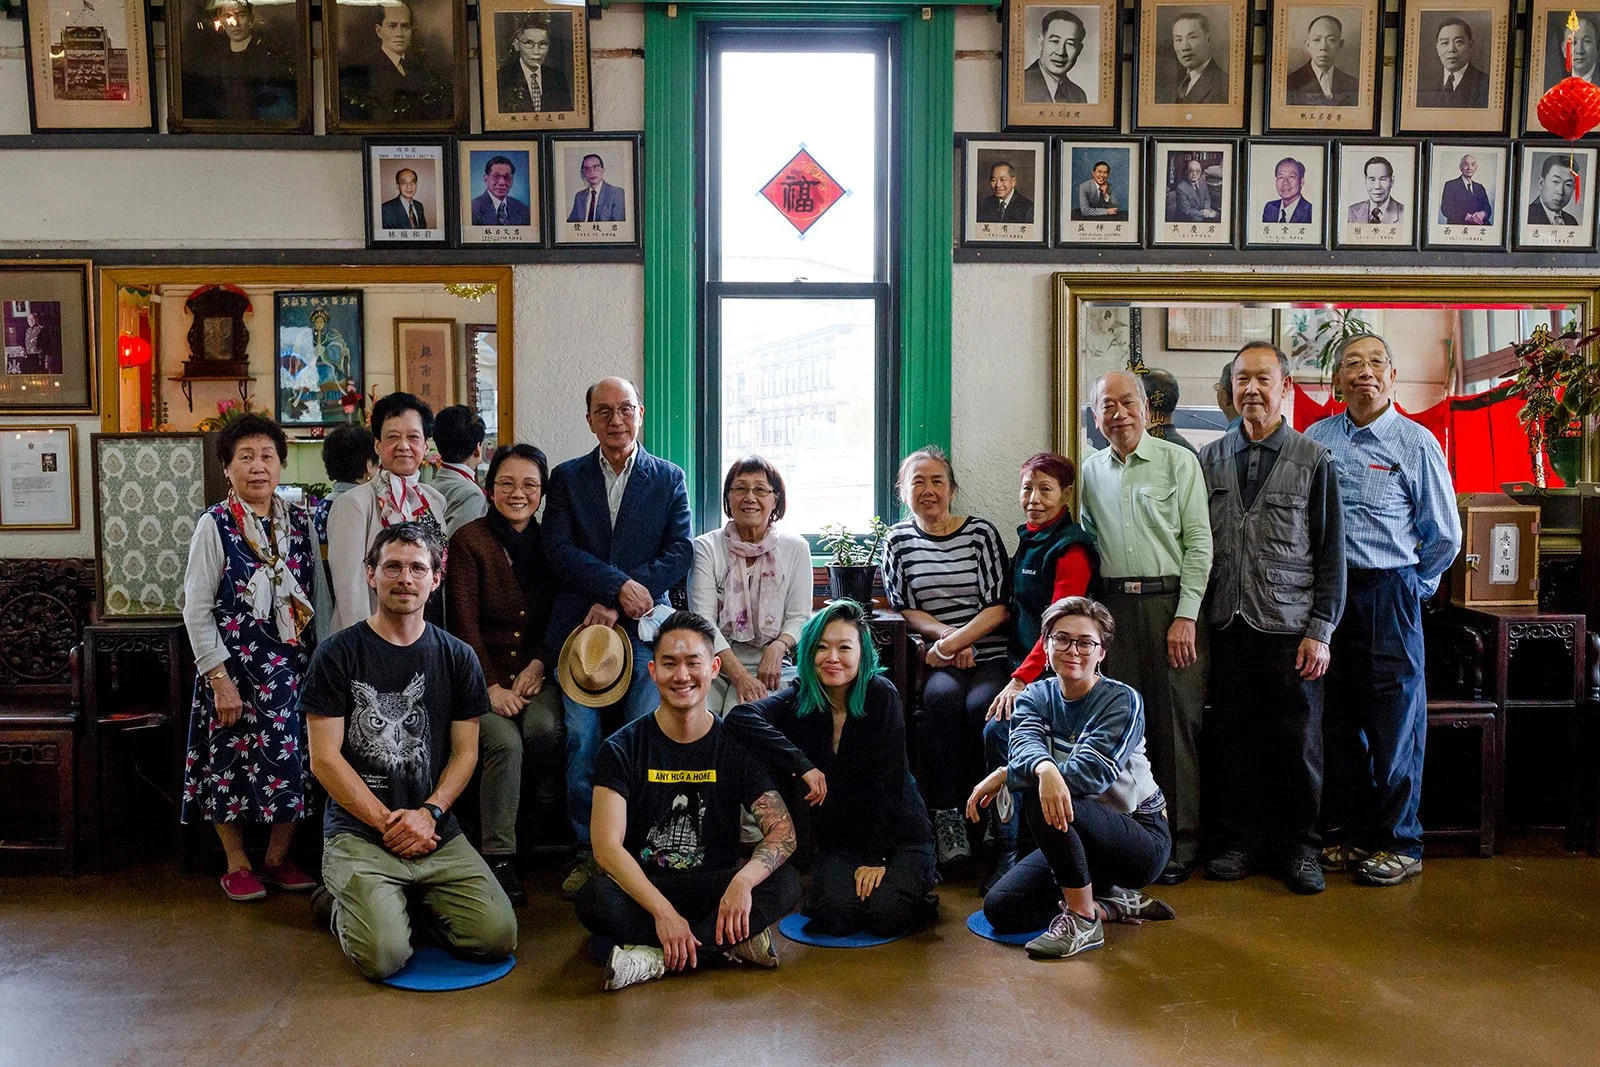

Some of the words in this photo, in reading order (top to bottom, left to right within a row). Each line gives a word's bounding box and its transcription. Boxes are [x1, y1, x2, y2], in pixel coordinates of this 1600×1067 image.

[780, 175, 821, 213] 福
[1499, 531, 1511, 577] 意見箱
[655, 772, 669, 781] ANY
